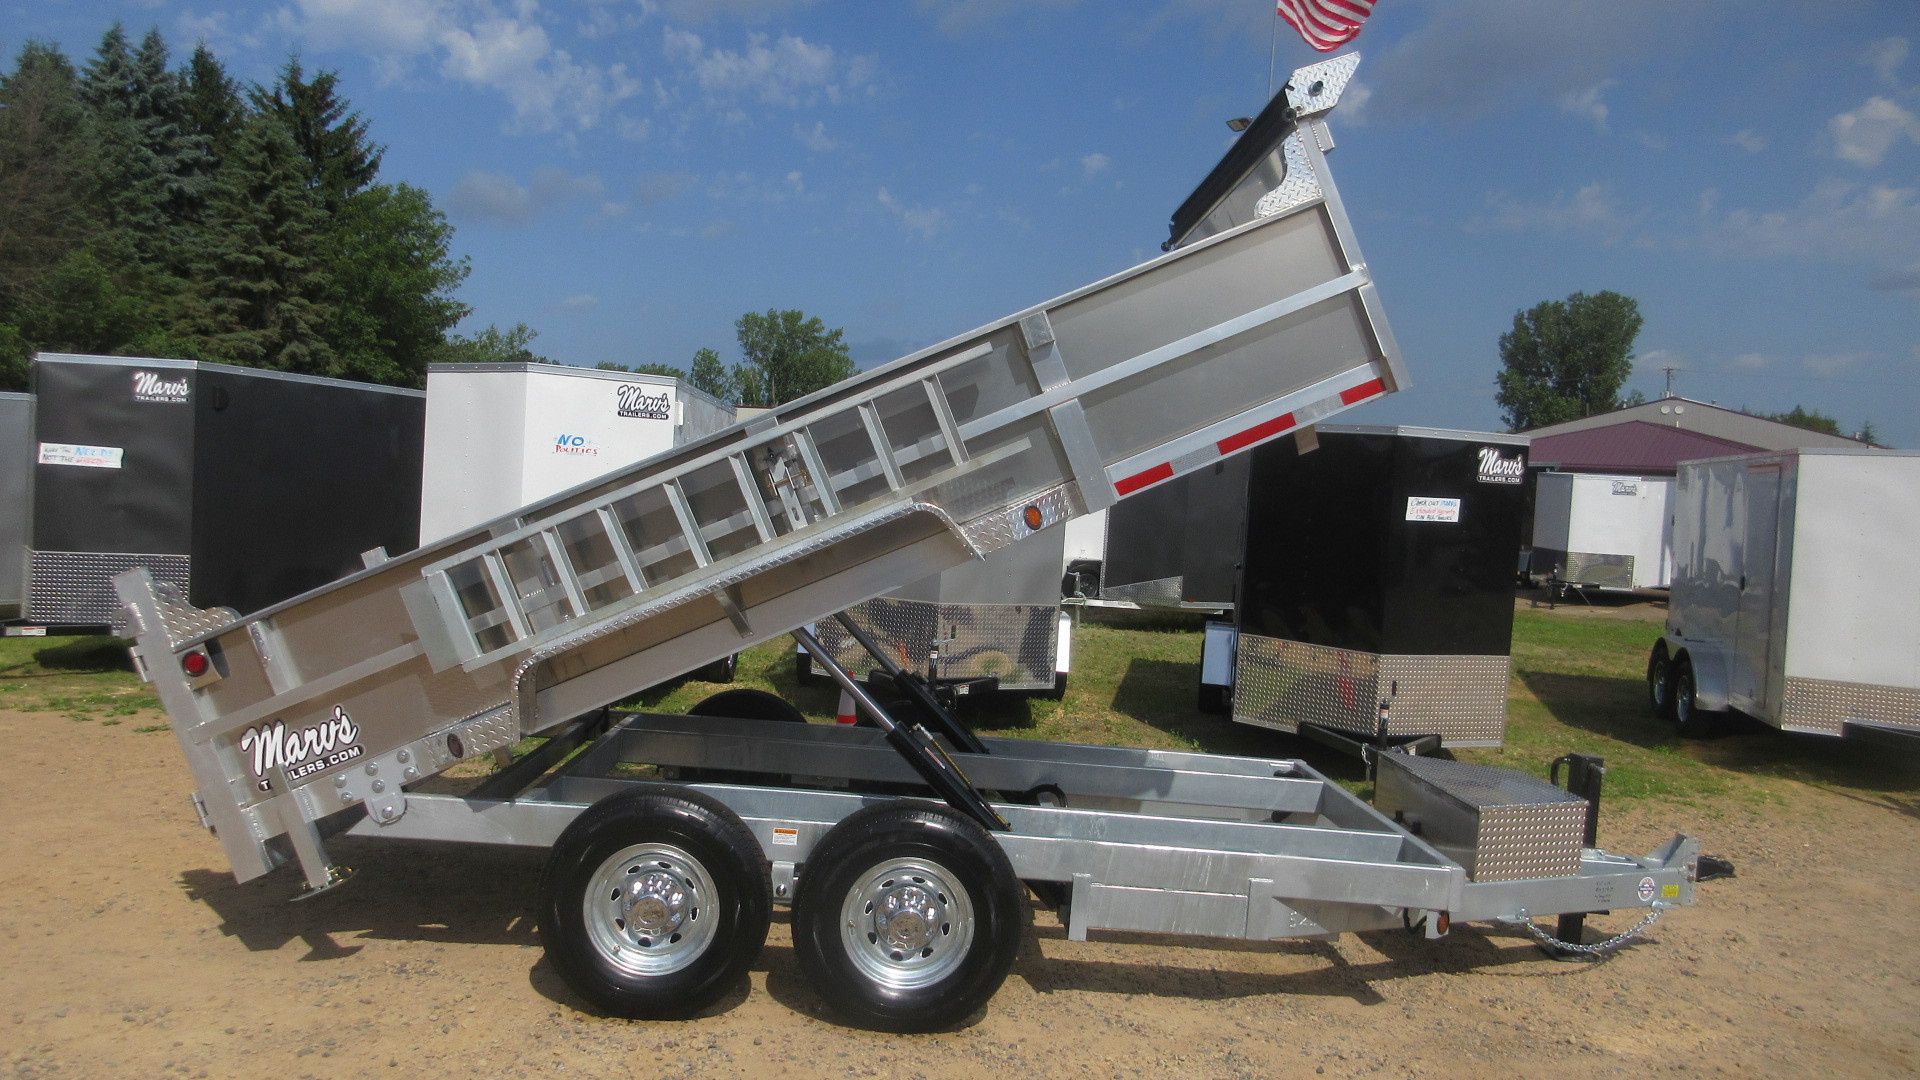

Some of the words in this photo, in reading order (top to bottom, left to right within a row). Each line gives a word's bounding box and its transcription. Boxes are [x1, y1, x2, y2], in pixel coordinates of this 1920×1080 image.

[134, 371, 190, 396] Marv's
[618, 385, 670, 412] Marv's
[619, 411, 668, 419] TRAILERS.COM
[557, 434, 585, 446] NO
[1478, 448, 1523, 475] Marv's
[241, 705, 358, 775] Marv's
